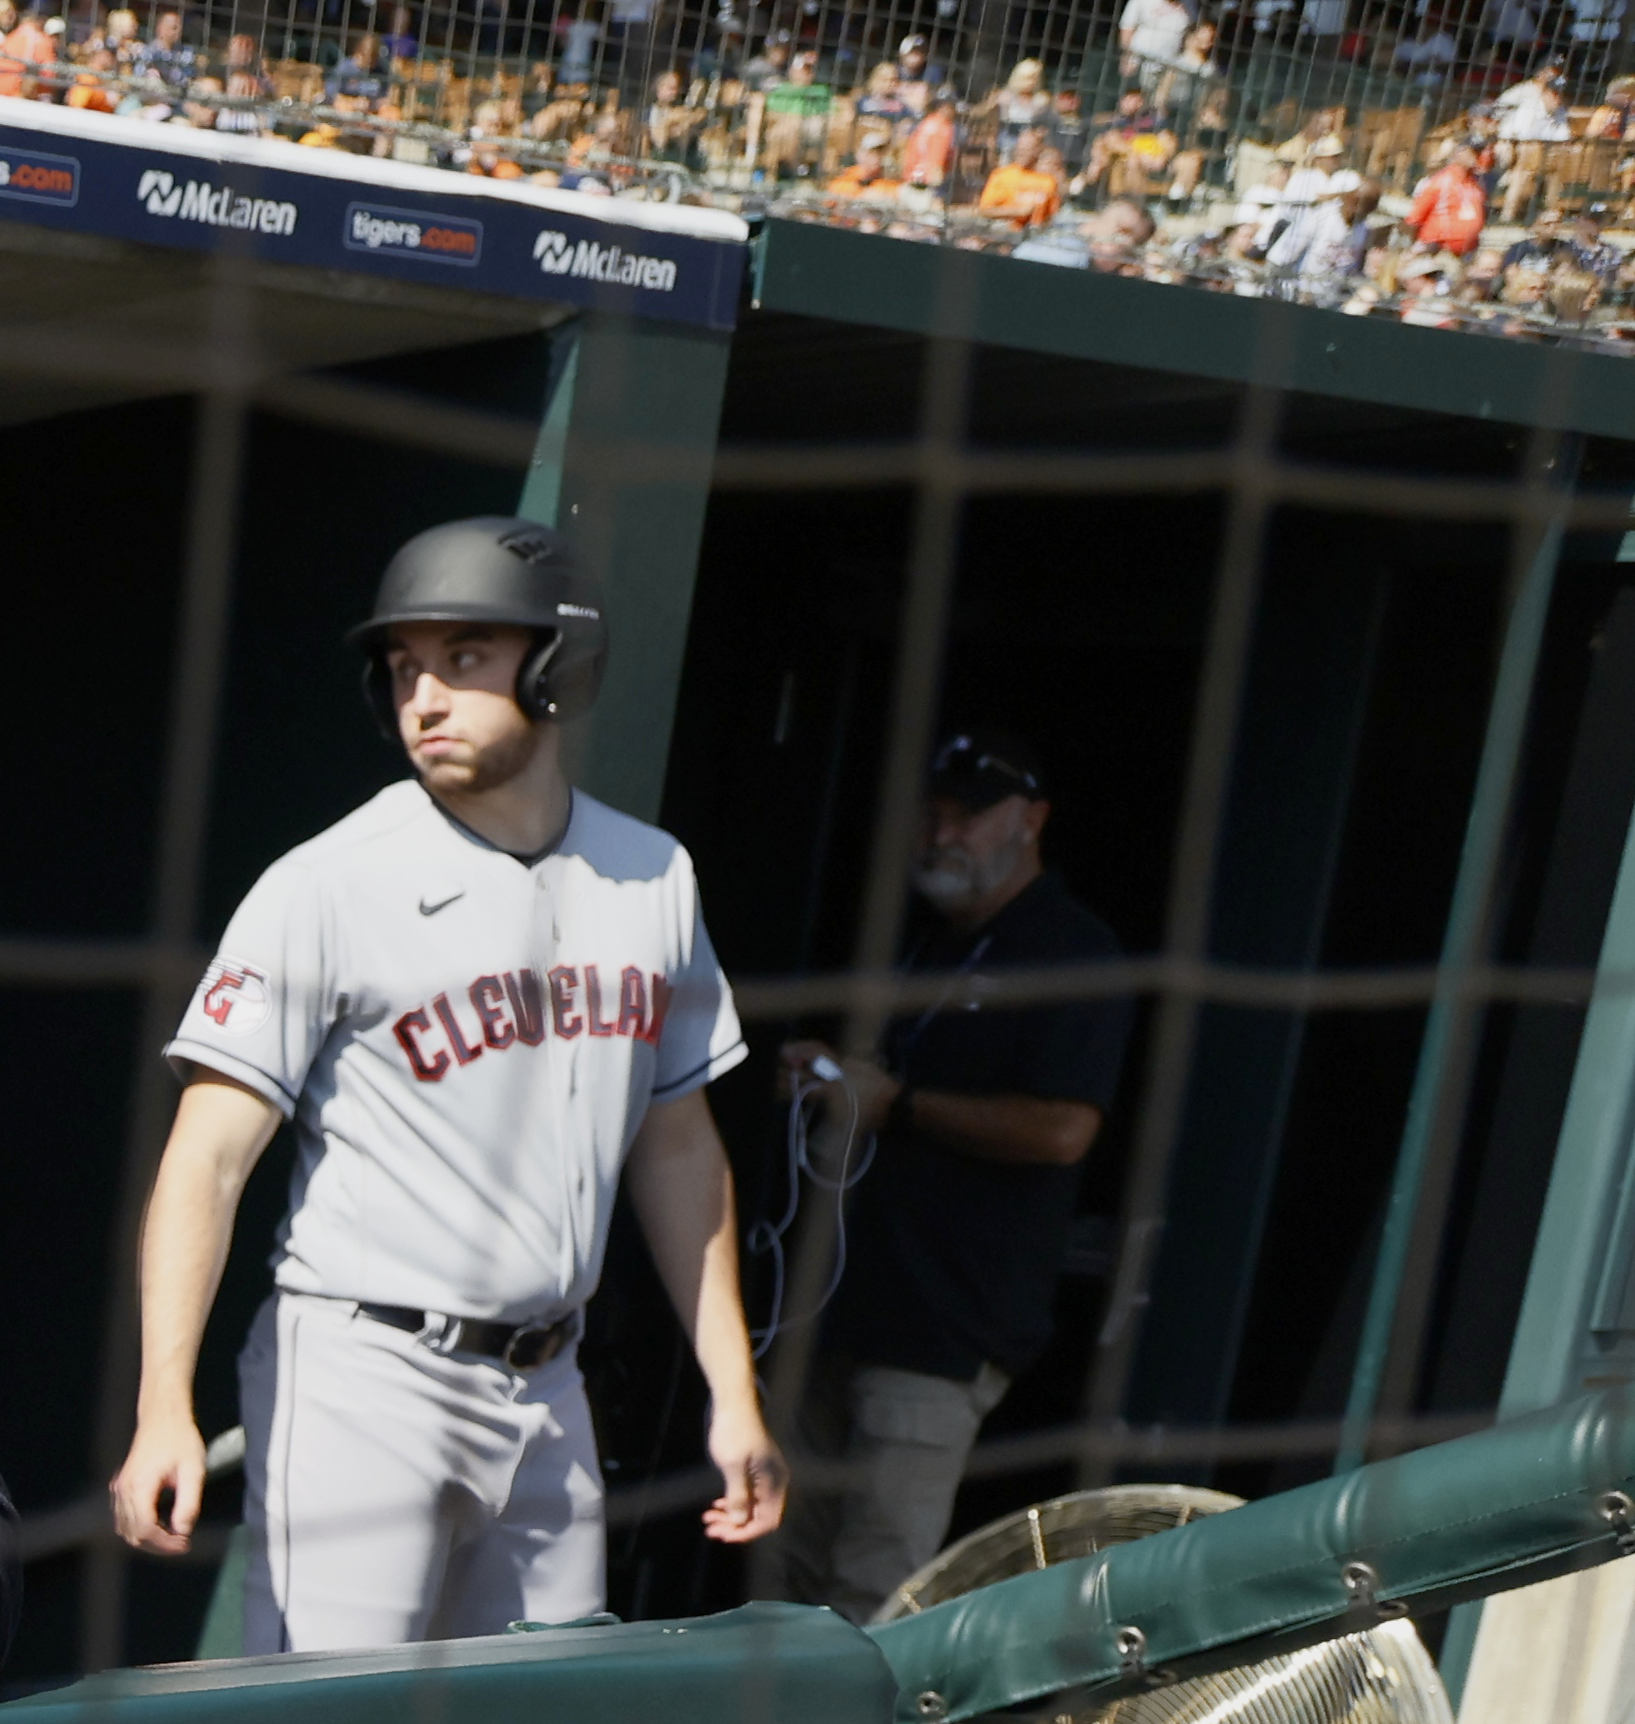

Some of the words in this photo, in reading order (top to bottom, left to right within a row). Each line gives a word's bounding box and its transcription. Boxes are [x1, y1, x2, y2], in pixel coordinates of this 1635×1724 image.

[180, 181, 297, 235] McLaren
[352, 212, 476, 253] tigers.com
[571, 240, 676, 291] McLaren
